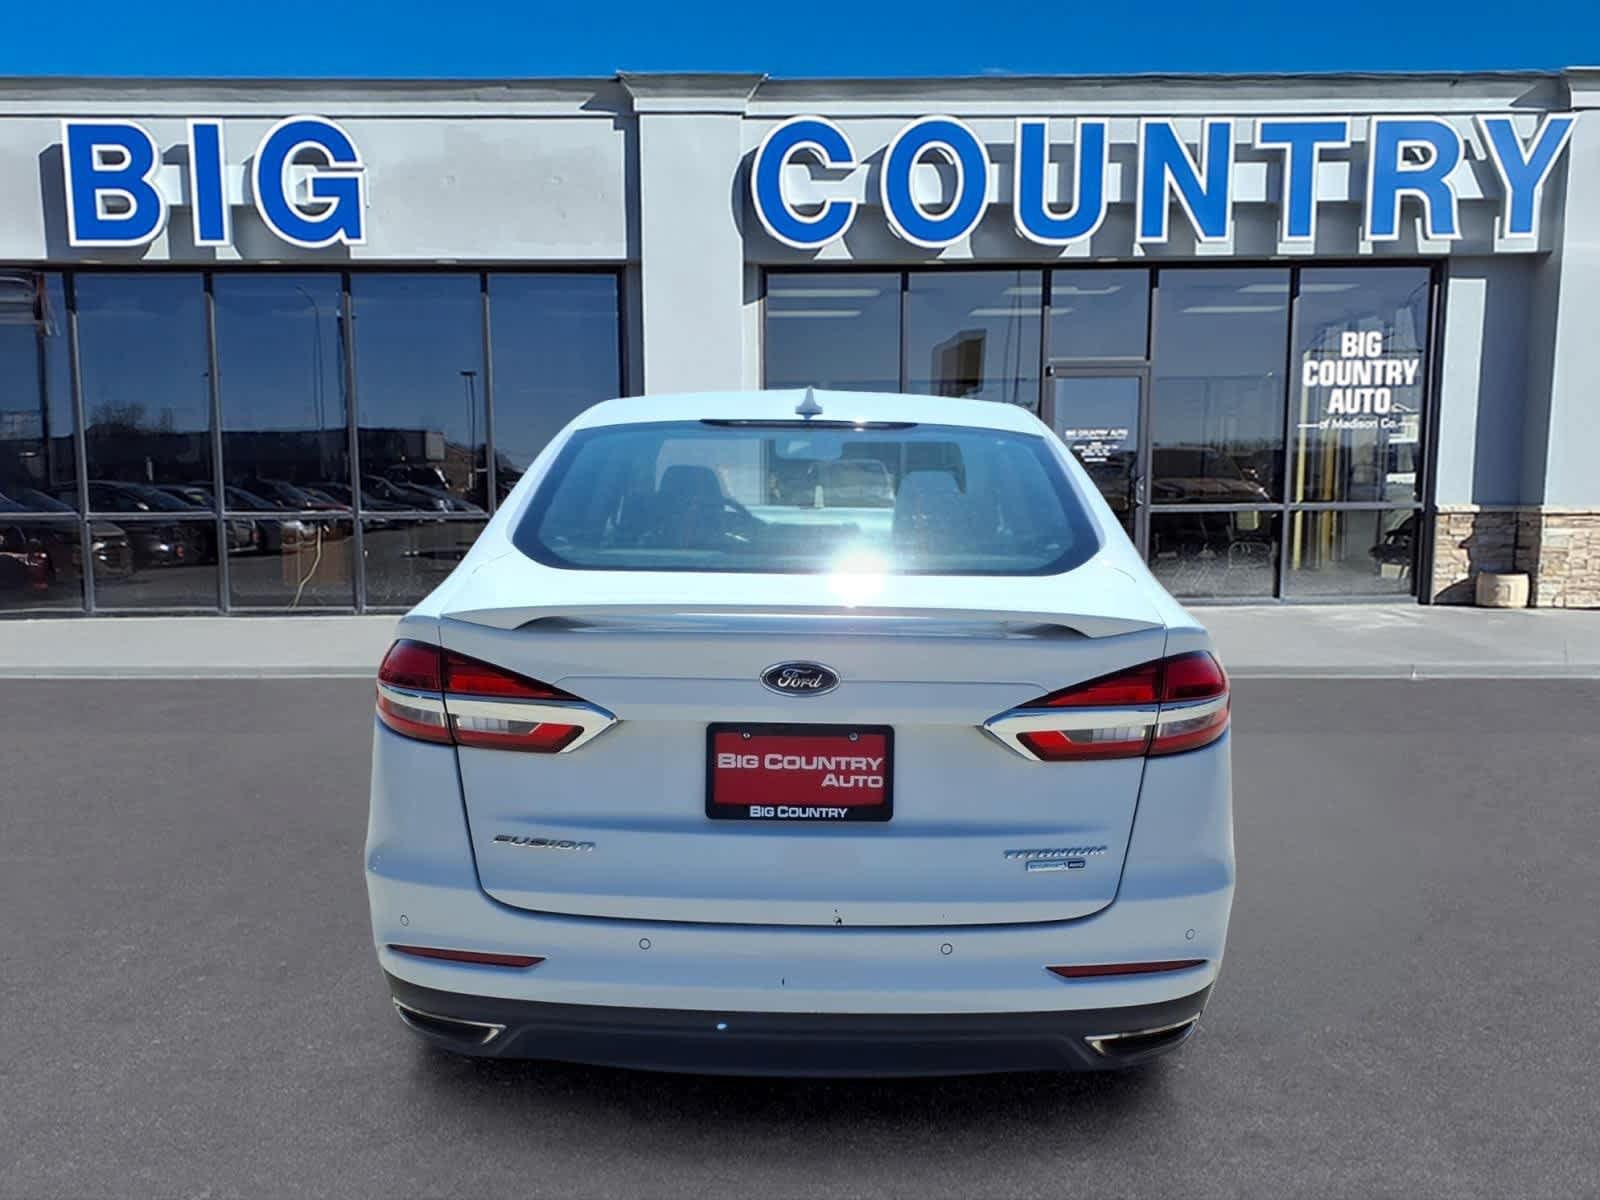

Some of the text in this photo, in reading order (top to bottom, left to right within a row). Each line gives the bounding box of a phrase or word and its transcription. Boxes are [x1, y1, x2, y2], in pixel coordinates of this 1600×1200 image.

[61, 112, 1576, 248] BIG COUNTRY
[1341, 331, 1382, 358] BIG
[1302, 359, 1420, 387] COUNTRY
[1327, 387, 1391, 414] AUTO
[777, 668, 823, 689] Ford
